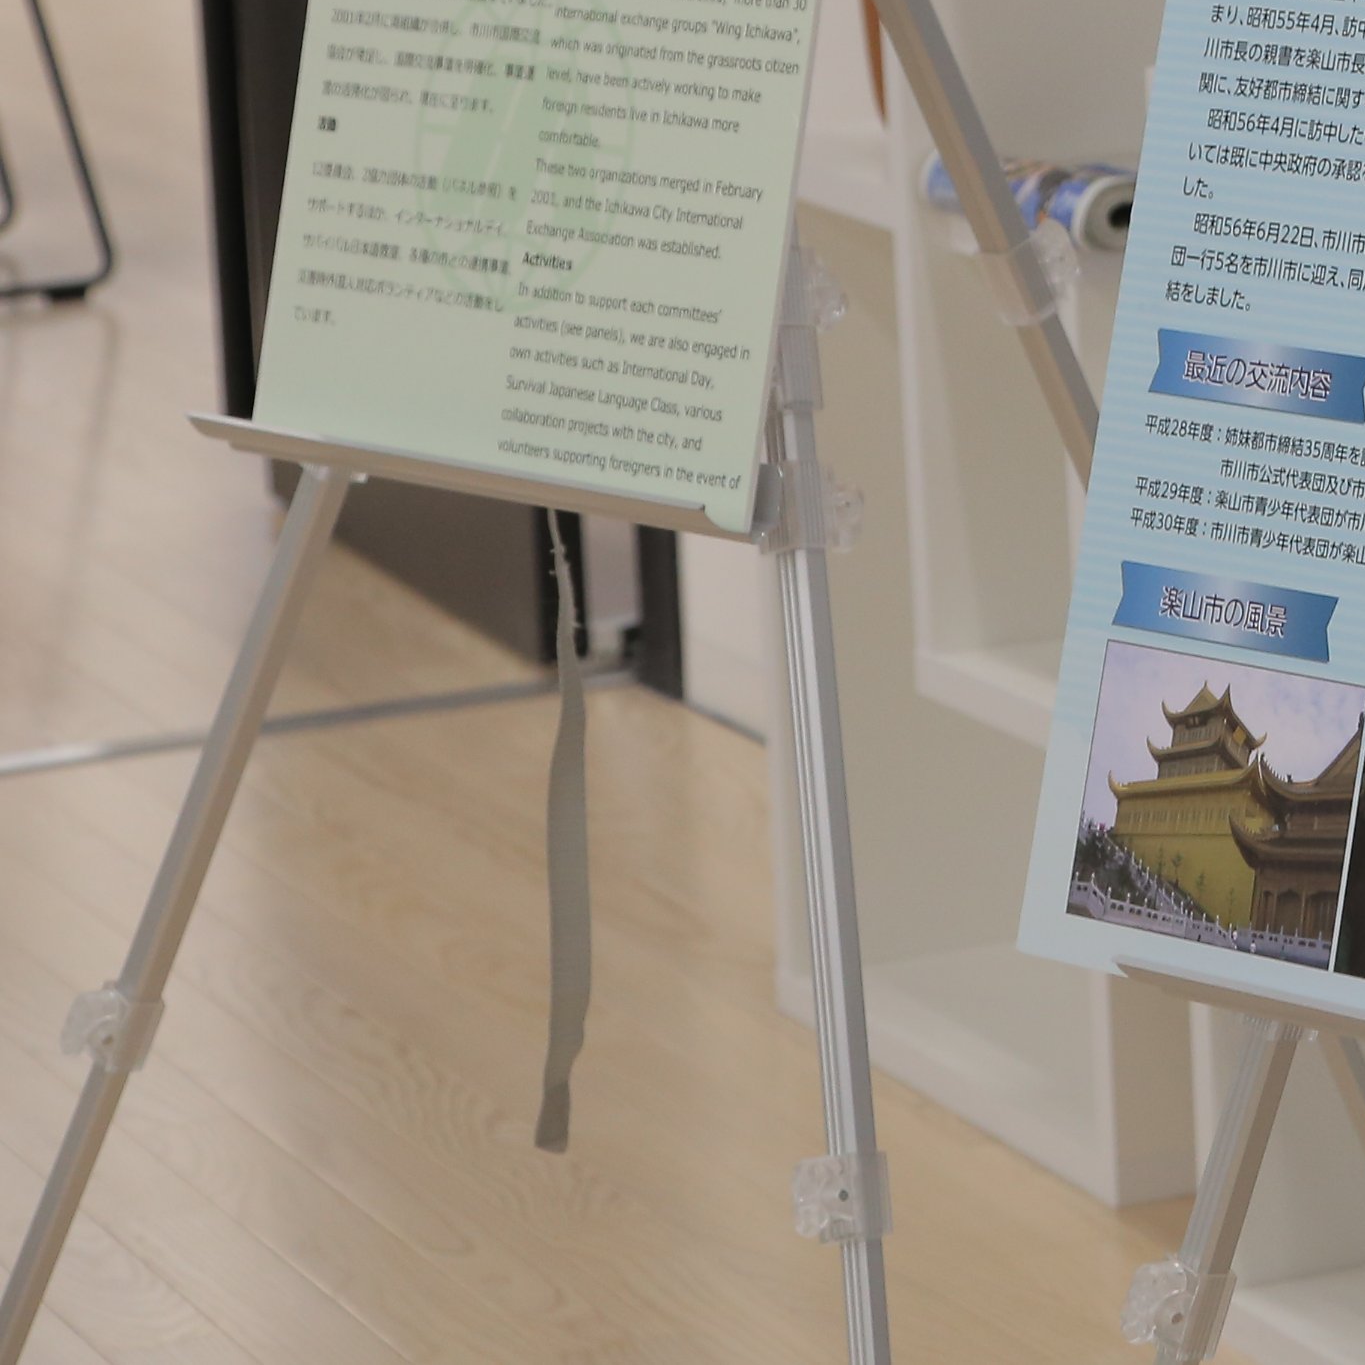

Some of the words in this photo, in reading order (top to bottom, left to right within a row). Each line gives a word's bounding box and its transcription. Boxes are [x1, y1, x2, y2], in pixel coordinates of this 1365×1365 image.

[659, 173, 699, 196] merged
[702, 179, 713, 193] in
[715, 179, 762, 203] February
[1181, 175, 1216, 200] した。
[521, 249, 573, 273] Activities
[1164, 279, 1253, 312] 結をしました。
[621, 357, 688, 387] International
[1183, 349, 1332, 403] 最近の交流内容
[597, 387, 647, 414] Language
[683, 402, 722, 421] various
[1160, 585, 1287, 639] 楽山市の風景
